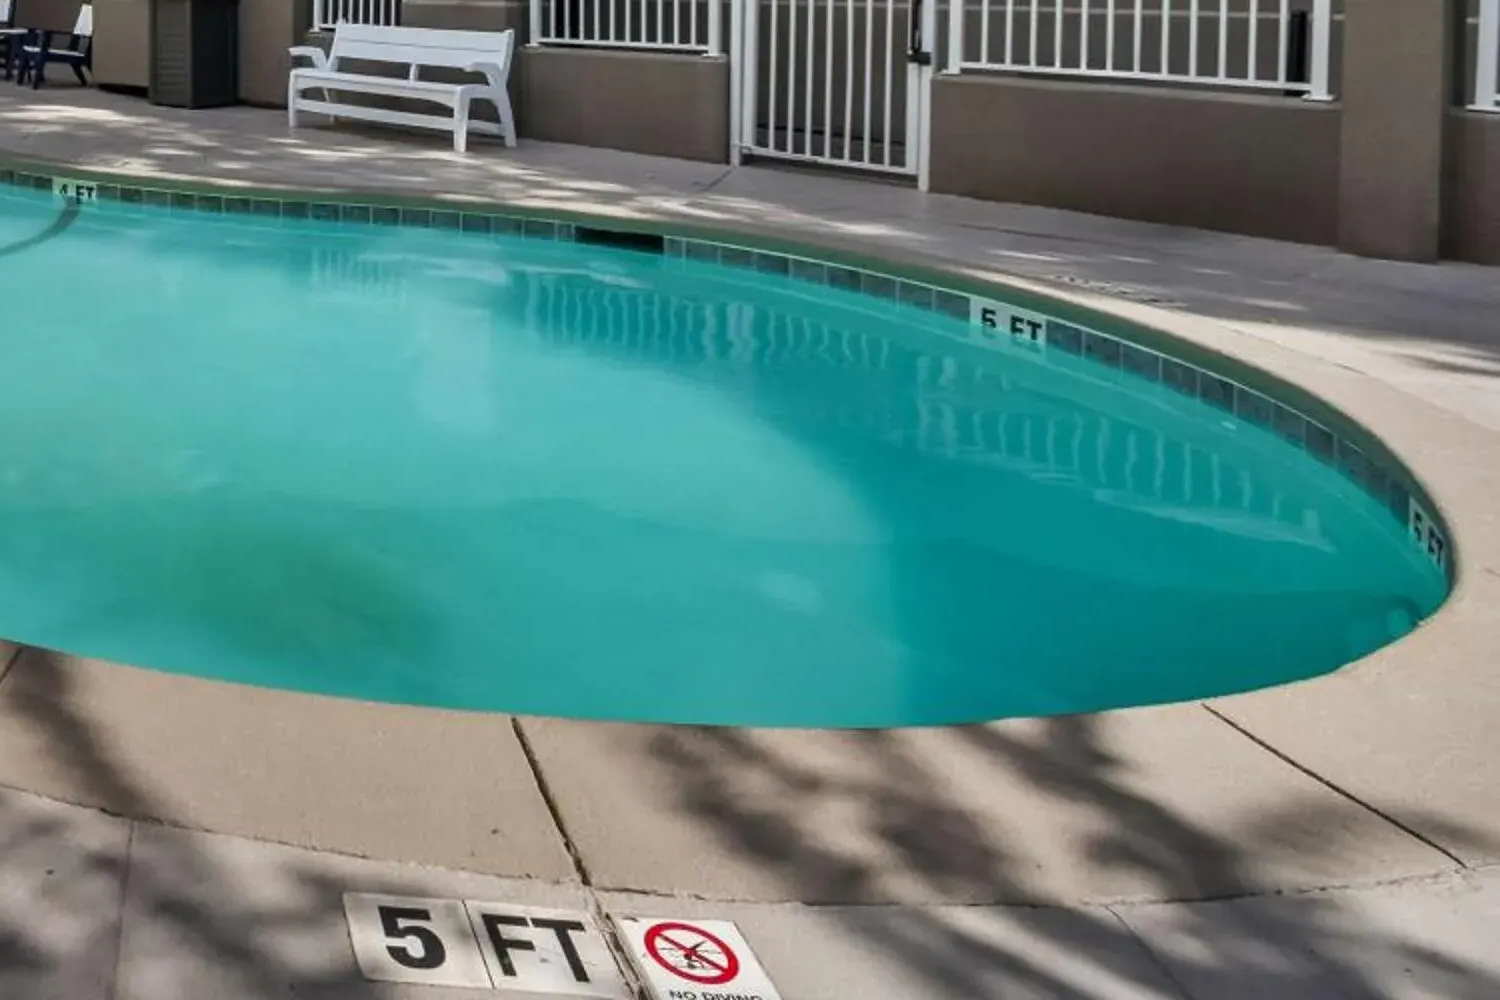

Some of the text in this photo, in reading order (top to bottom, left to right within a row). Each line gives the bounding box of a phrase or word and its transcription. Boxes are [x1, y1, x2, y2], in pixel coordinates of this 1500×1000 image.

[981, 307, 1043, 341] 5 FT
[377, 905, 592, 983] 5 FT
[668, 989, 697, 1000] NO
